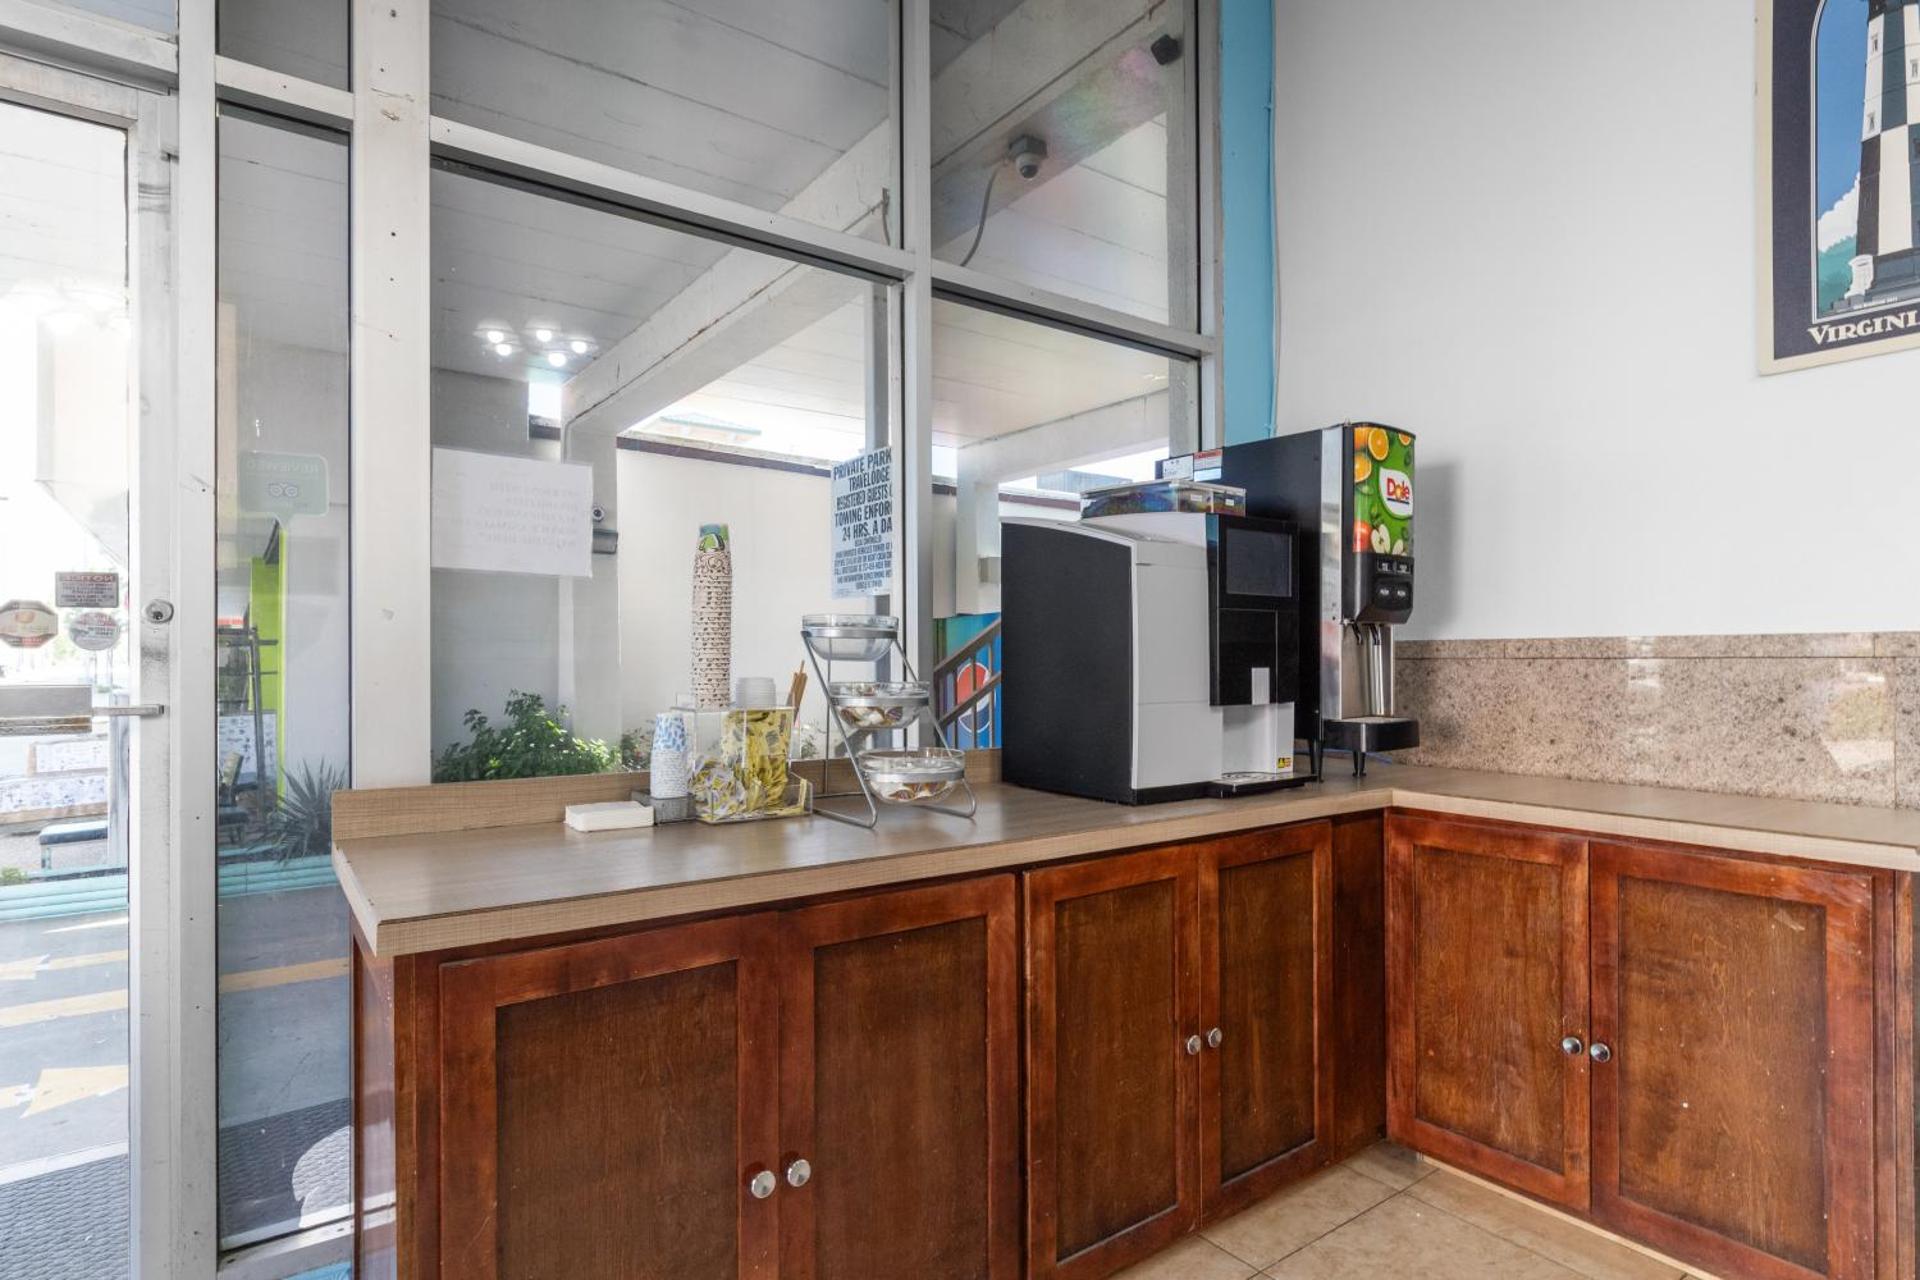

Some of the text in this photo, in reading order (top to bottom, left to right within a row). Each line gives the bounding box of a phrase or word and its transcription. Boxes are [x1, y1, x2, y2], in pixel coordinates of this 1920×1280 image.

[1807, 310, 1920, 345] VIRGINI
[834, 456, 864, 480] PRIVATE
[849, 465, 890, 492] TRAVELODGE
[836, 489, 866, 512] REGISTERED
[867, 483, 888, 503] GUESTS
[1387, 477, 1410, 500] Dole
[834, 500, 892, 529] TOWING ENFOR
[842, 526, 851, 542] 24
[853, 521, 870, 539] HRS.
[873, 519, 878, 536] A
